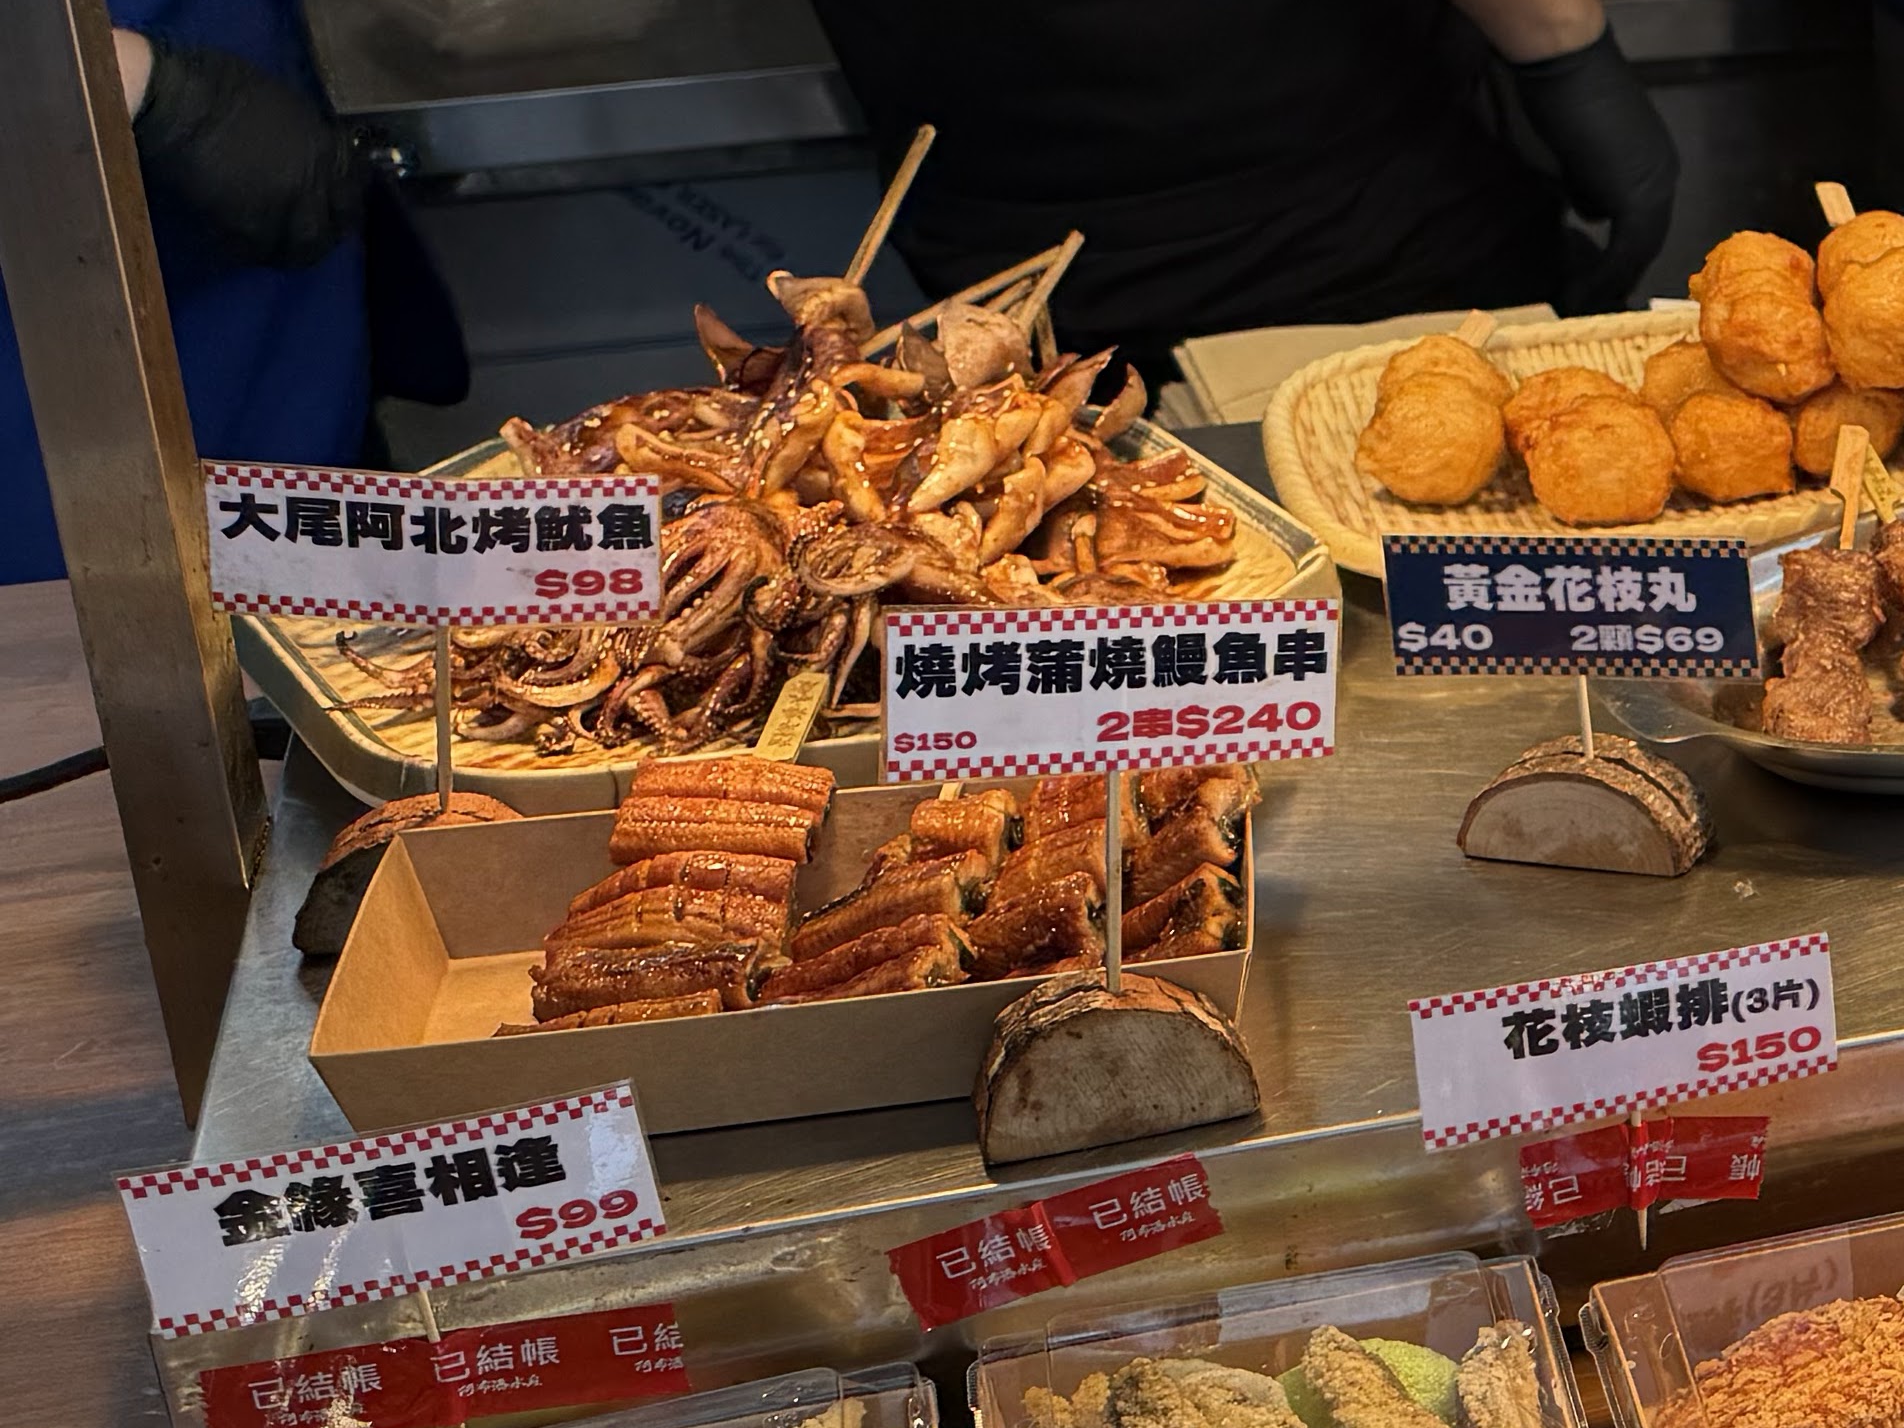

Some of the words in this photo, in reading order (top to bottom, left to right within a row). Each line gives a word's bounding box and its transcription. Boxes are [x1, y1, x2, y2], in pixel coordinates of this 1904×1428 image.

[219, 491, 655, 555] 大尾阿北烤魷魚
[533, 568, 644, 601] $98
[1443, 563, 1697, 613] 黃金花枝丸
[1398, 621, 1494, 653] $40
[1569, 623, 1725, 655] 2顆$69
[895, 628, 1330, 700] 燒烤蒲燒鰻魚串
[894, 730, 978, 754] $150
[1096, 701, 1322, 743] 2串$240
[1501, 977, 1821, 1060] 花枝蝦排(3片)
[1697, 1025, 1823, 1073] $150
[515, 1190, 639, 1241] $99
[1088, 1173, 1206, 1231] 已結帳
[936, 1223, 1052, 1280] 已結帳
[430, 1336, 560, 1383] 已結帳
[248, 1362, 383, 1410] 已結帳
